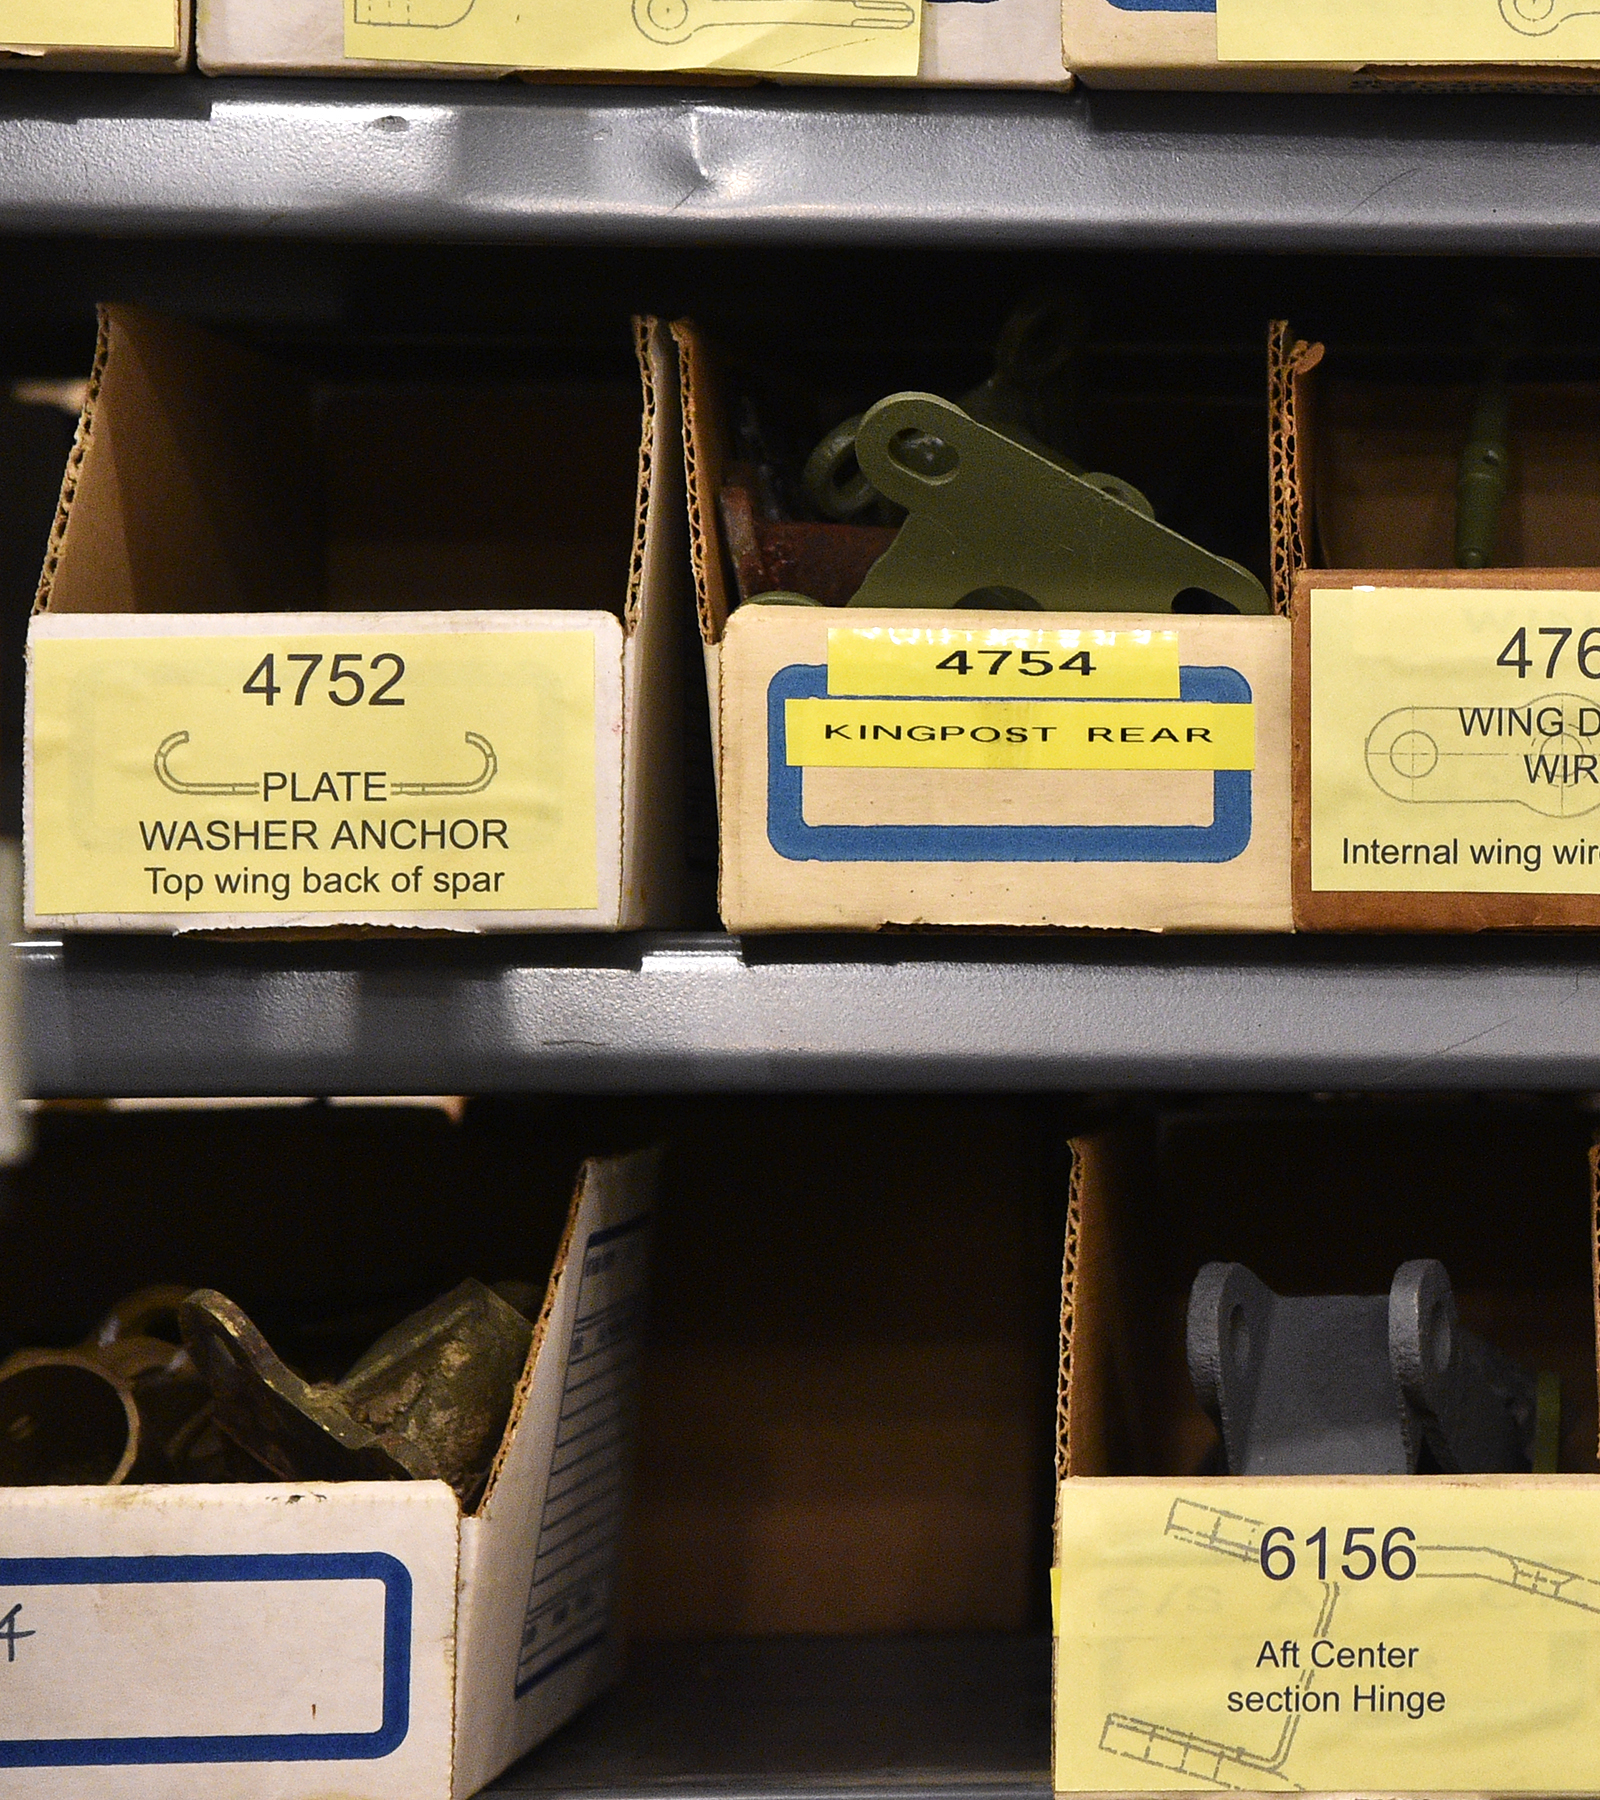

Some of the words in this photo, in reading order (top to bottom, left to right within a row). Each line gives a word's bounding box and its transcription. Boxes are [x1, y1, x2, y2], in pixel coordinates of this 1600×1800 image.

[935, 650, 1097, 677] 4754
[242, 653, 405, 707] 4752
[825, 724, 1057, 743] KINGPOST
[1088, 727, 1213, 743] REAR
[1458, 707, 1564, 738] WING
[263, 771, 387, 802] PLATE
[139, 820, 319, 851] WASHER
[330, 819, 509, 850] ANCHOR
[1343, 837, 1458, 865] Internal
[1469, 844, 1541, 872] wing
[143, 867, 204, 901] Top
[214, 873, 290, 901] wing
[303, 866, 380, 894] back
[391, 865, 424, 893] of
[433, 872, 505, 900] spar
[1260, 1526, 1417, 1581] 6156
[1256, 1640, 1300, 1668] Aft
[1311, 1640, 1419, 1668] Center
[1227, 1686, 1340, 1712] section
[1353, 1684, 1446, 1720] Hinge
